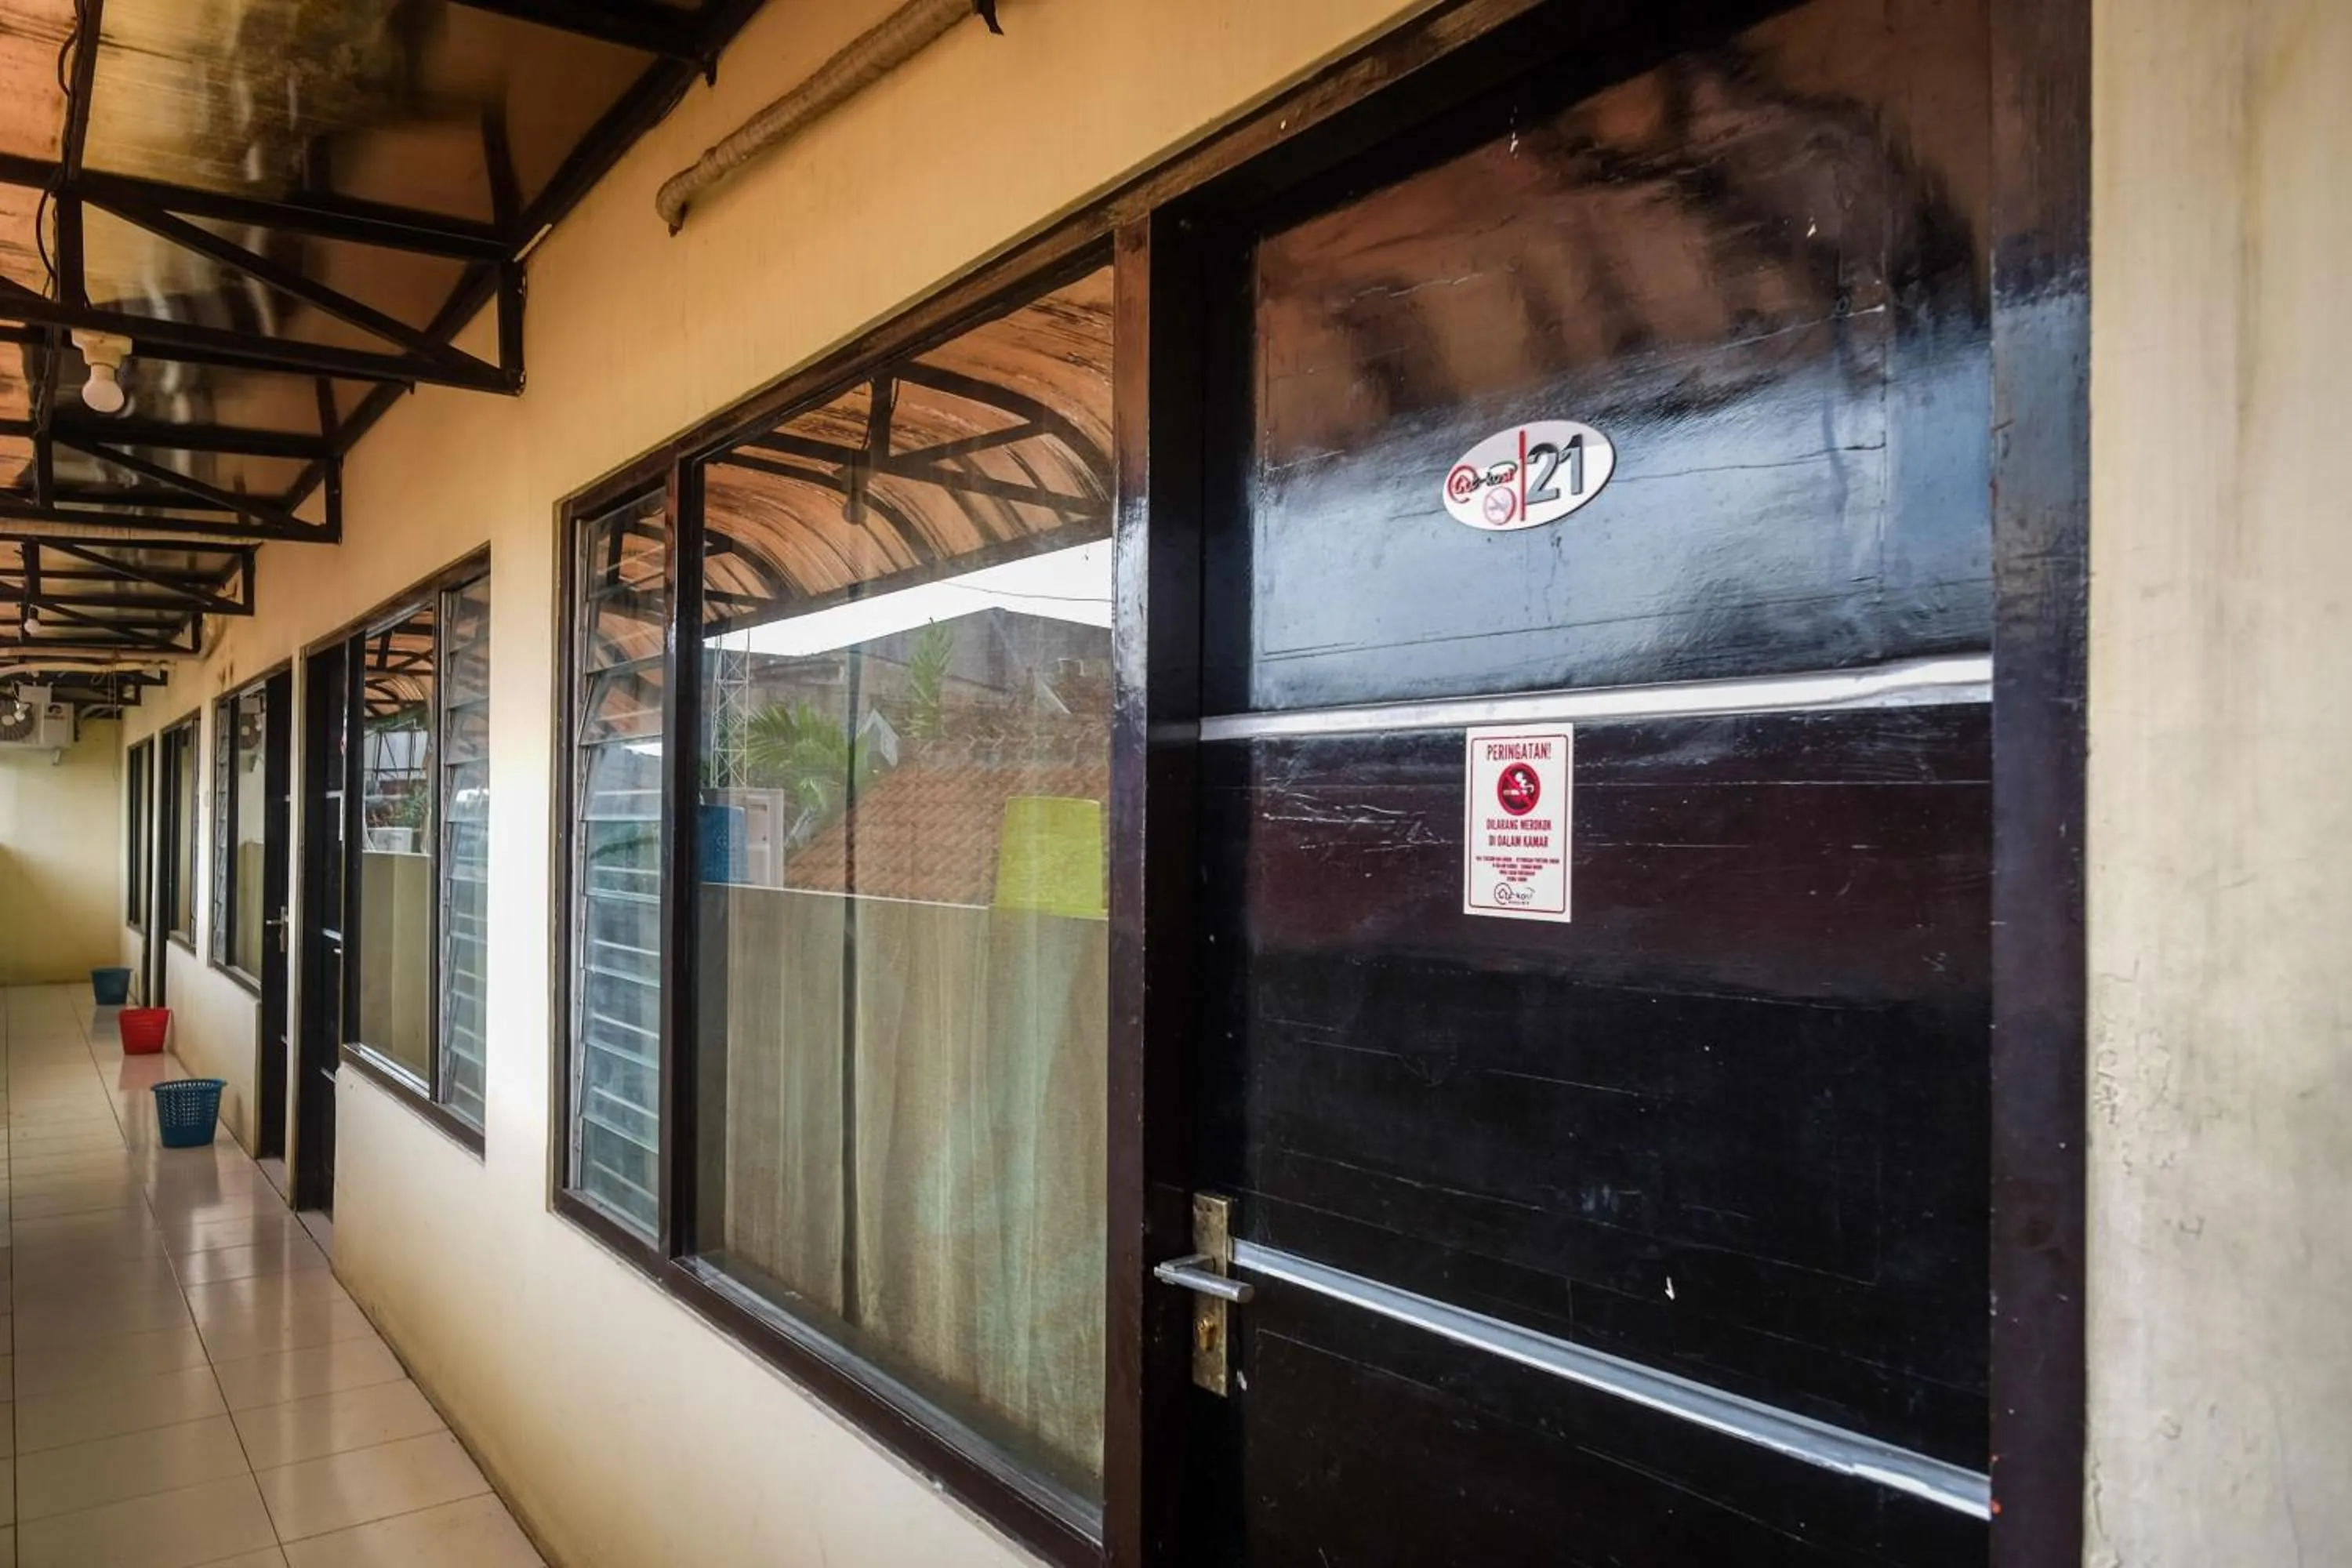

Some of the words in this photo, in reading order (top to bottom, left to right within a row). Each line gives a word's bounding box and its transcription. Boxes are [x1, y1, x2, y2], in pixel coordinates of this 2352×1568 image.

[1526, 433, 1584, 506] 21
[1486, 742, 1552, 760] PERINGATAN!
[1486, 818, 1519, 830] DILARANG
[1489, 835, 1496, 847] DI
[1497, 835, 1521, 848] DALAM
[1523, 836, 1548, 848] KAMAR
